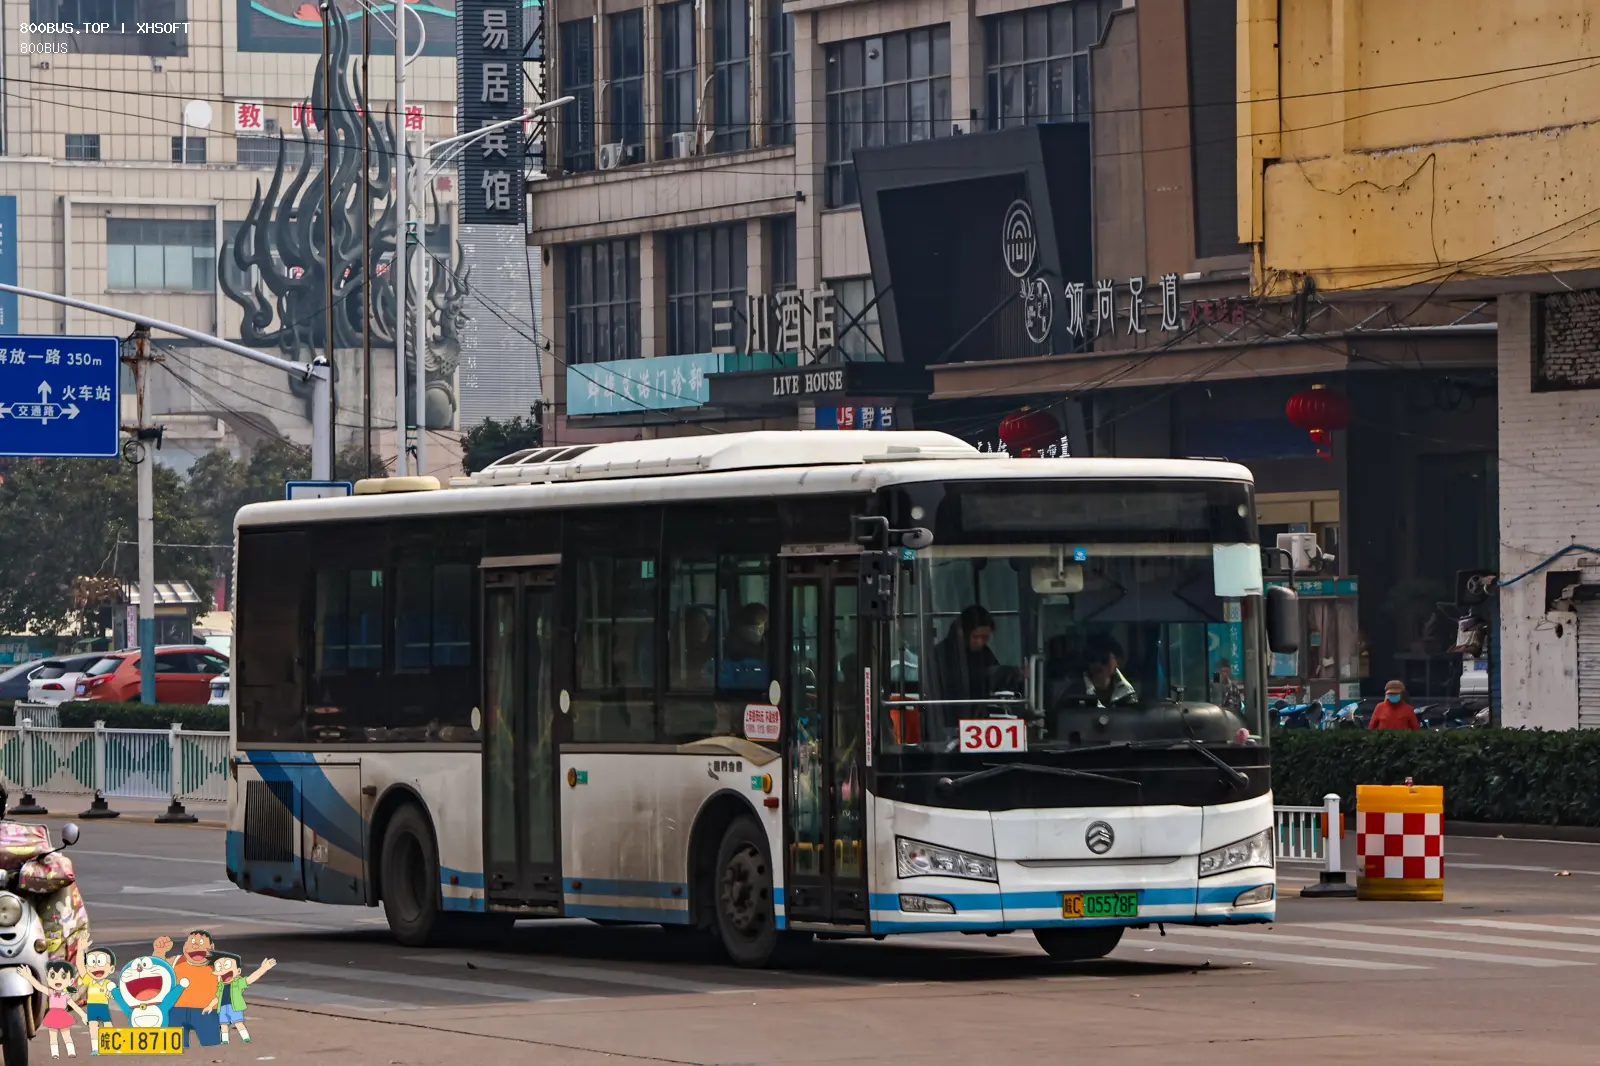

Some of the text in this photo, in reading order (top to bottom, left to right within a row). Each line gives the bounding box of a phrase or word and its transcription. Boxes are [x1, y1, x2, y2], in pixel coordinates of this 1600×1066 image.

[480, 9, 511, 211] 易居宾馆
[1065, 272, 1179, 338] 领尚足道
[711, 282, 835, 356] 三川酒店
[66, 352, 102, 366] 350m
[61, 385, 111, 401] 火车站
[772, 370, 843, 396] LIVE HOUSE
[18, 405, 55, 417] 交通路
[964, 725, 1018, 749] 301
